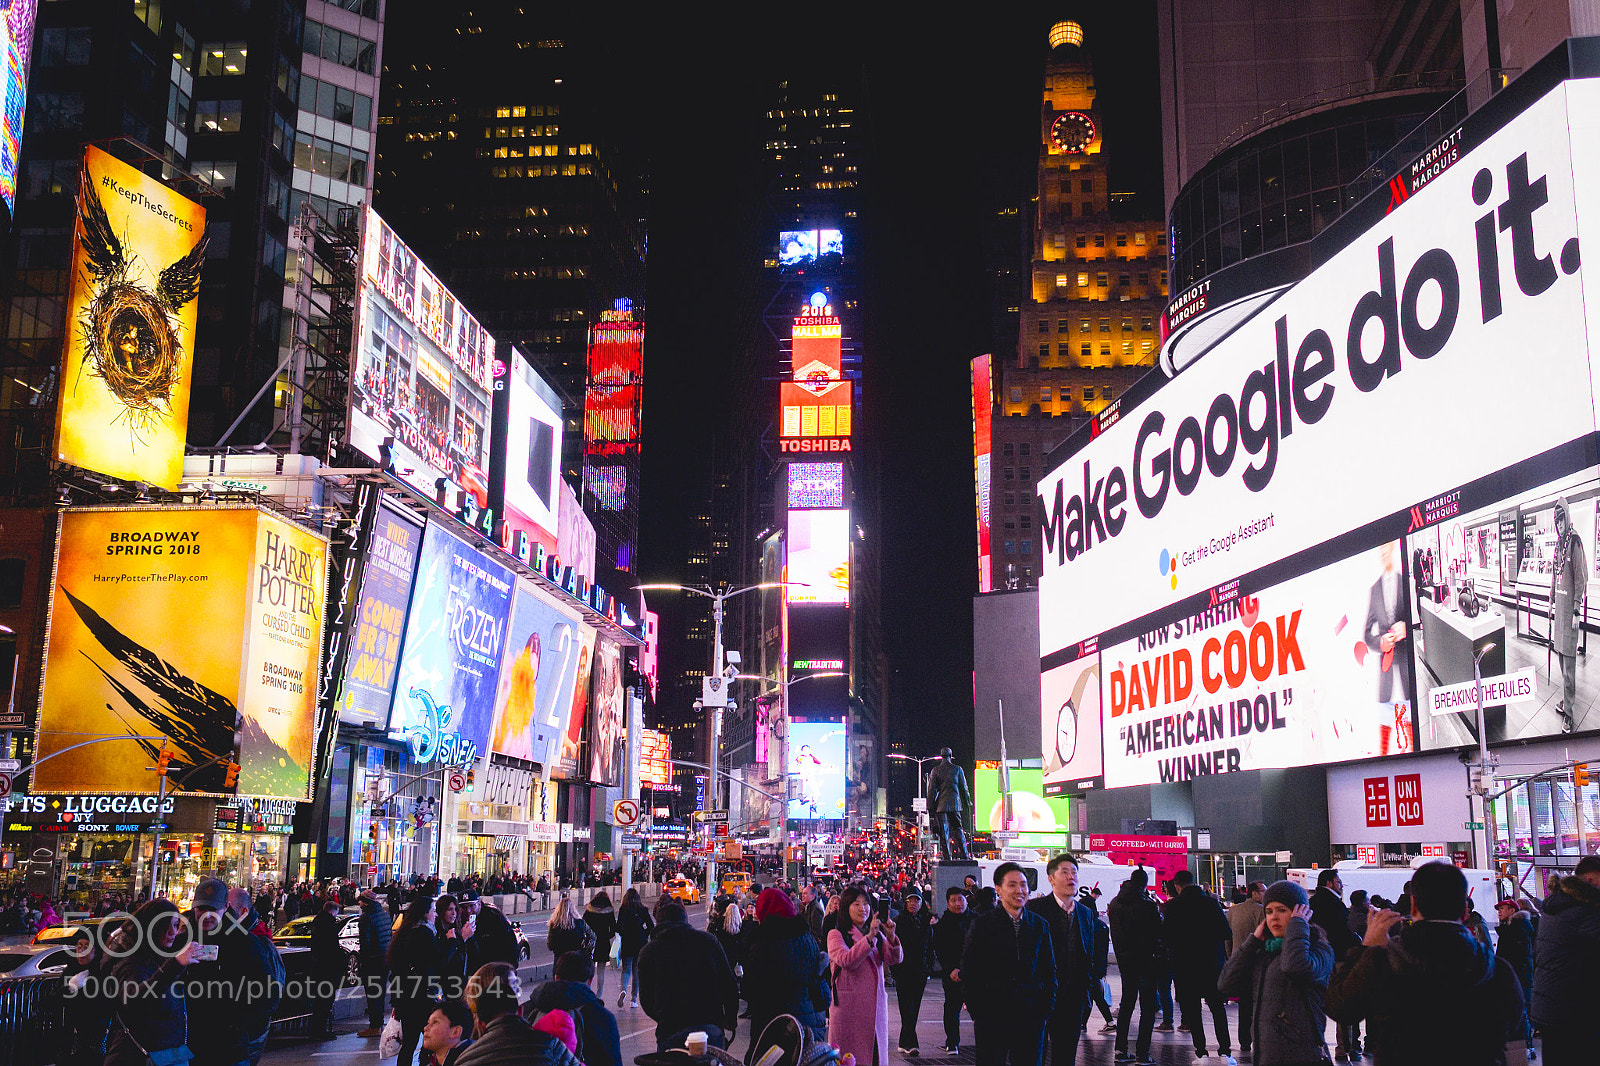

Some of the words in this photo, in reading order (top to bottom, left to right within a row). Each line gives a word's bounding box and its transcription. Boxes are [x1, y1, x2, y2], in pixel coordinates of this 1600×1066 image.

[1411, 126, 1463, 176] MARRIOTT
[1412, 148, 1458, 192] MARQUIS
[102, 175, 194, 232] #KeepTheSecrets
[1169, 279, 1211, 316] MARRIOTT
[793, 317, 840, 326] TOSHIBA
[801, 305, 832, 317] 2018
[1170, 297, 1206, 330] MARQUIS
[1037, 459, 1127, 567] Make
[1133, 314, 1335, 520] Google
[1346, 235, 1460, 393] do
[1472, 151, 1582, 325] it.
[493, 380, 504, 391] G
[401, 421, 454, 475] VORNADO
[779, 438, 852, 453] TOSHIBA
[1425, 490, 1461, 512] MARRIOTT
[1426, 503, 1458, 523] MARQUIS
[110, 531, 200, 542] BROADWAY
[1181, 549, 1196, 567] Get
[1196, 545, 1209, 561] the
[1209, 530, 1237, 554] Google
[1237, 512, 1275, 543] Assistant
[106, 545, 163, 555] SPRING
[169, 544, 201, 555] 2018
[264, 530, 318, 587] HARRY
[93, 573, 209, 584] HarryPotterThePlay.com
[257, 564, 318, 620] POTTER
[262, 613, 290, 633] CURSED
[290, 622, 311, 639] CHILD
[363, 596, 404, 637] COME
[440, 583, 503, 658] FROZEN
[1173, 594, 1259, 640] STARRING
[263, 661, 303, 681] BROADWAY
[350, 652, 395, 689] AWAY
[1110, 647, 1194, 719] DAVID
[1201, 608, 1306, 694] COOK
[261, 674, 287, 690] SPRING
[289, 682, 303, 695] 2018
[1434, 684, 1478, 709] BREAKING
[1499, 677, 1531, 699] RULES
[1158, 747, 1242, 785] WINNER
[1397, 780, 1418, 799] UNI
[64, 795, 175, 813] LUGGAGE
[259, 798, 296, 816] LUGGAGE
[1399, 801, 1420, 820] QLO
[9, 823, 33, 832] Nikon
[40, 823, 71, 832] Canon
[78, 824, 109, 832] SONY
[1110, 840, 1146, 848] COFFEED
[203, 849, 211, 868] ATM
[1382, 852, 1402, 862] LifeWear
